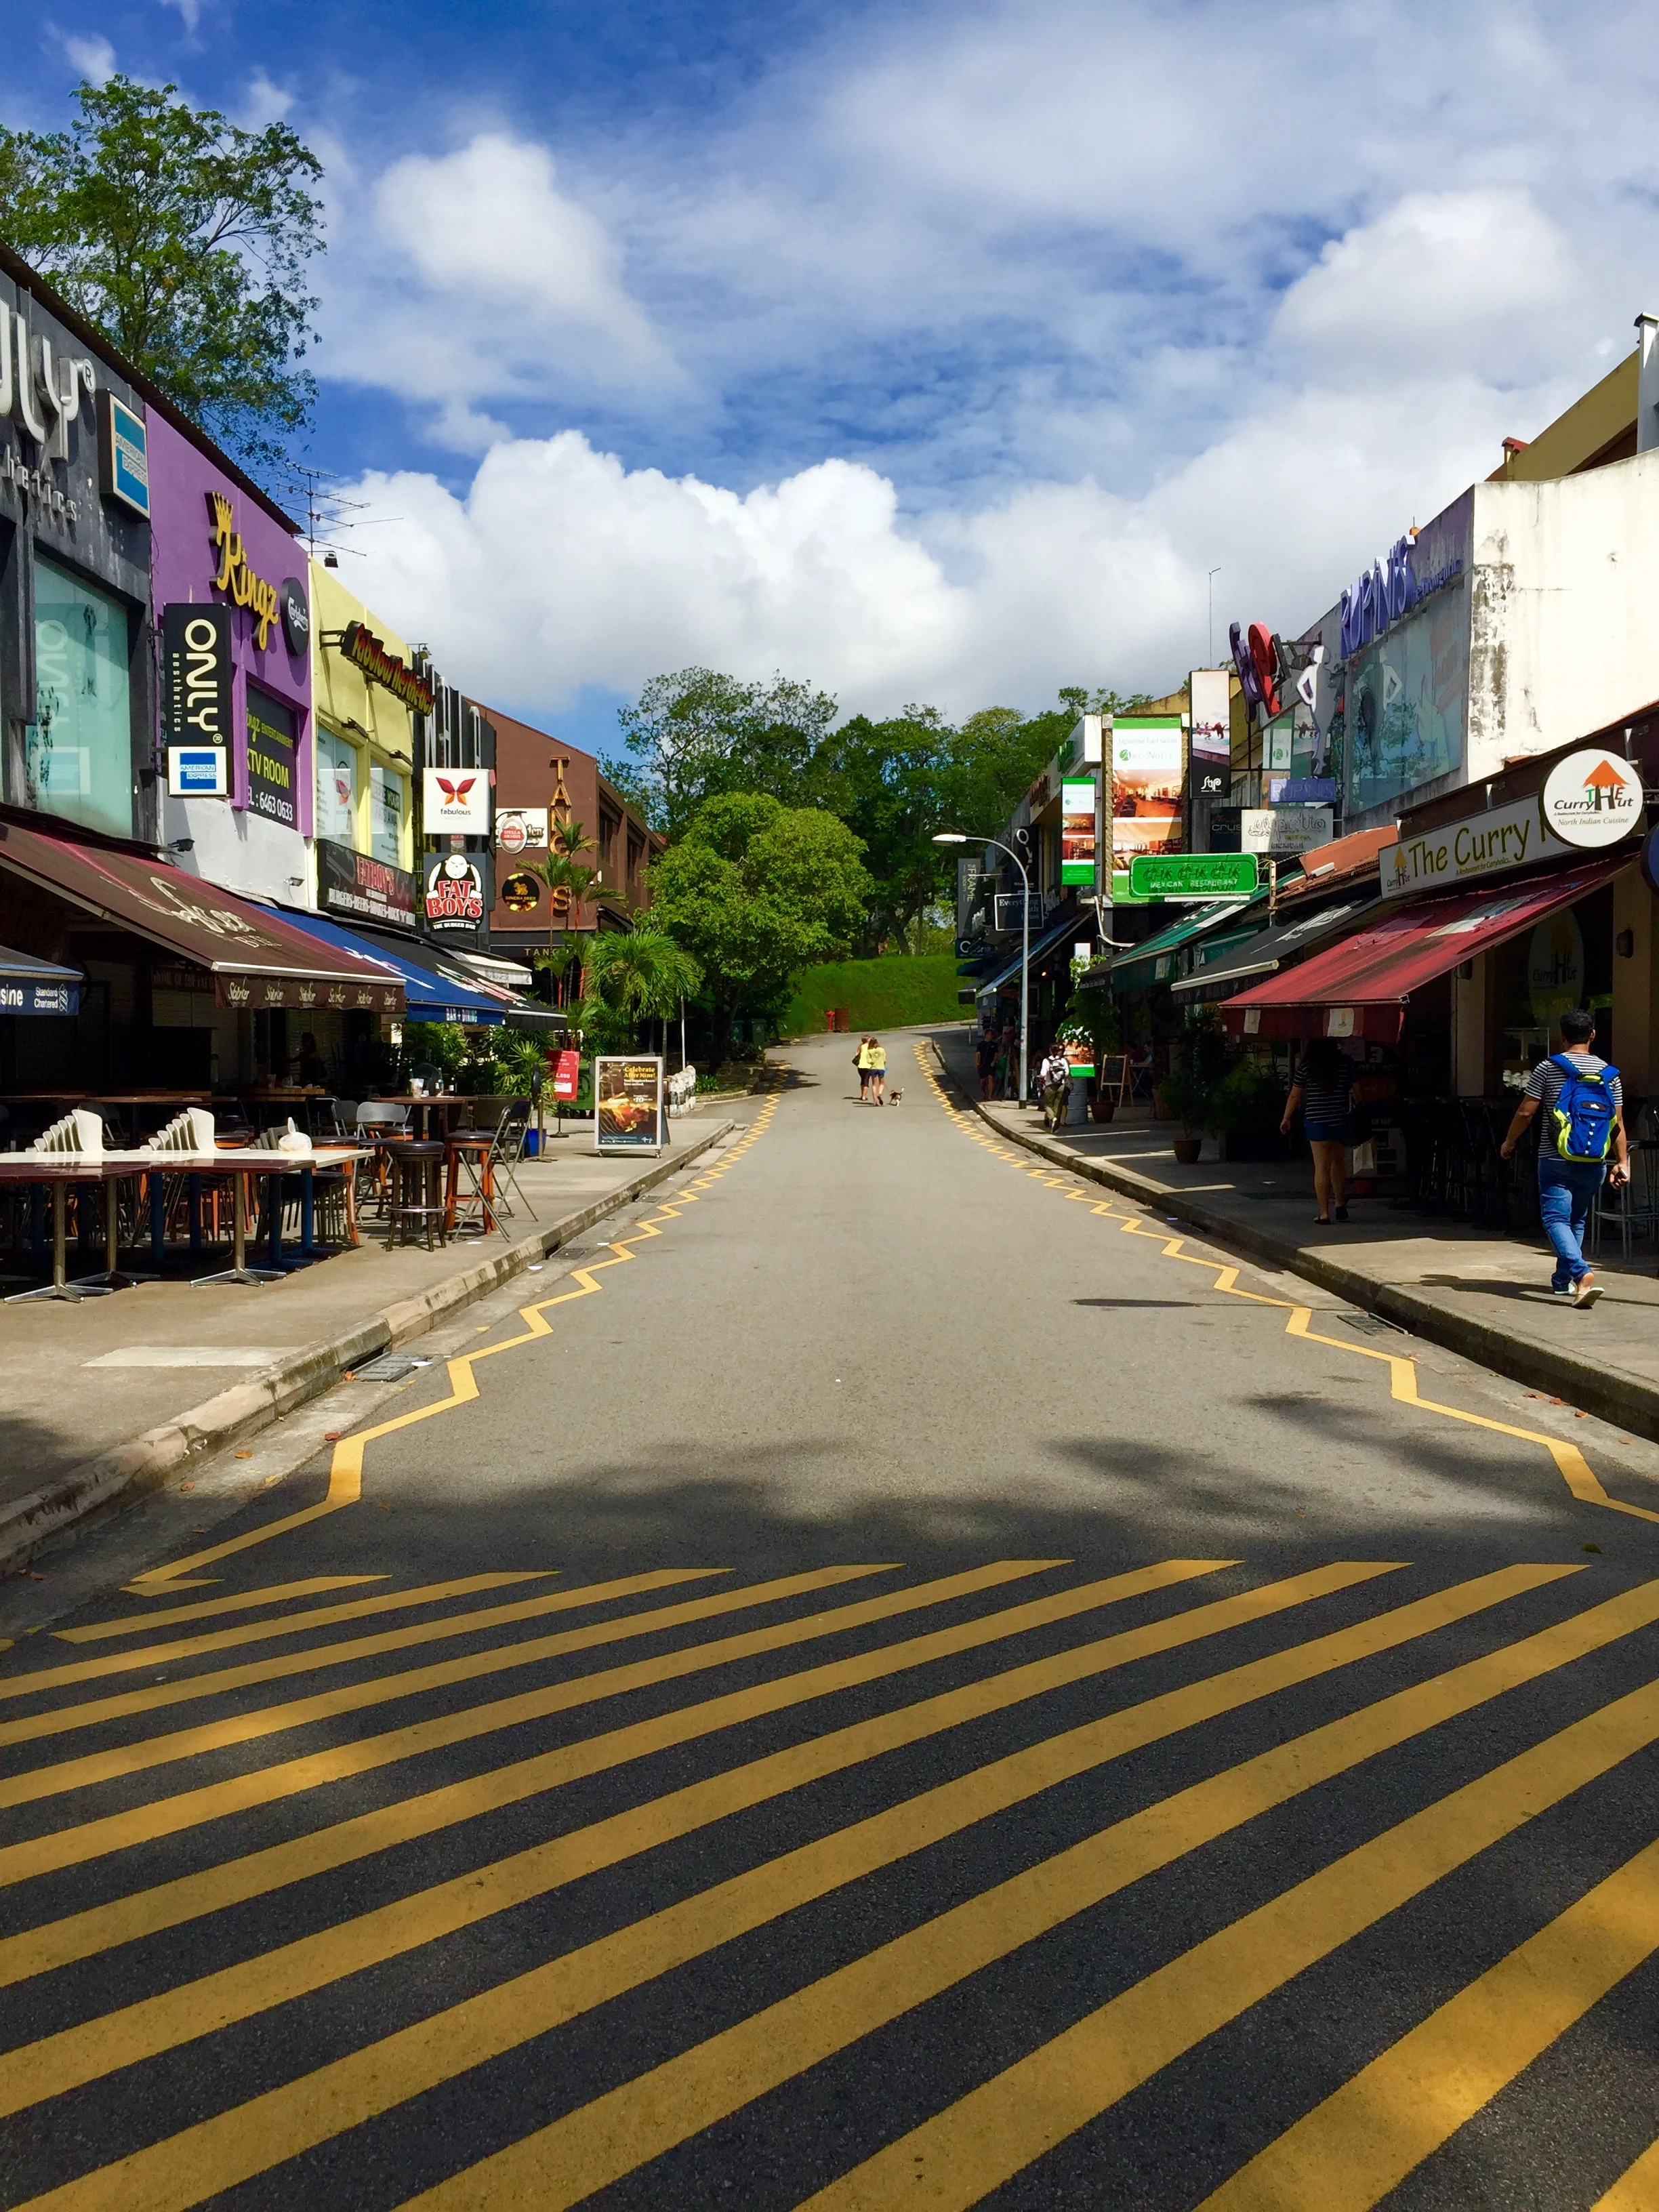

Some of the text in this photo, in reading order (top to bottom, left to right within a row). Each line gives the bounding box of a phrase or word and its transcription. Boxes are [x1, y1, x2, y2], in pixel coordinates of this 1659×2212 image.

[172, 653, 183, 732] aesthetics
[263, 758, 290, 789] ROOM
[260, 791, 276, 815] 6463
[276, 798, 293, 822] 0633
[1554, 800, 1595, 811] Curry
[1211, 823, 1242, 832] crus
[1558, 816, 1629, 826] North Indian Cuisine
[1408, 819, 1531, 878] The Curry
[438, 880, 474, 899] FAT
[1150, 881, 1183, 889] MEXICAN
[426, 897, 483, 918] BOY'S
[36, 987, 58, 998] Standard
[34, 998, 58, 1009] Chartered
